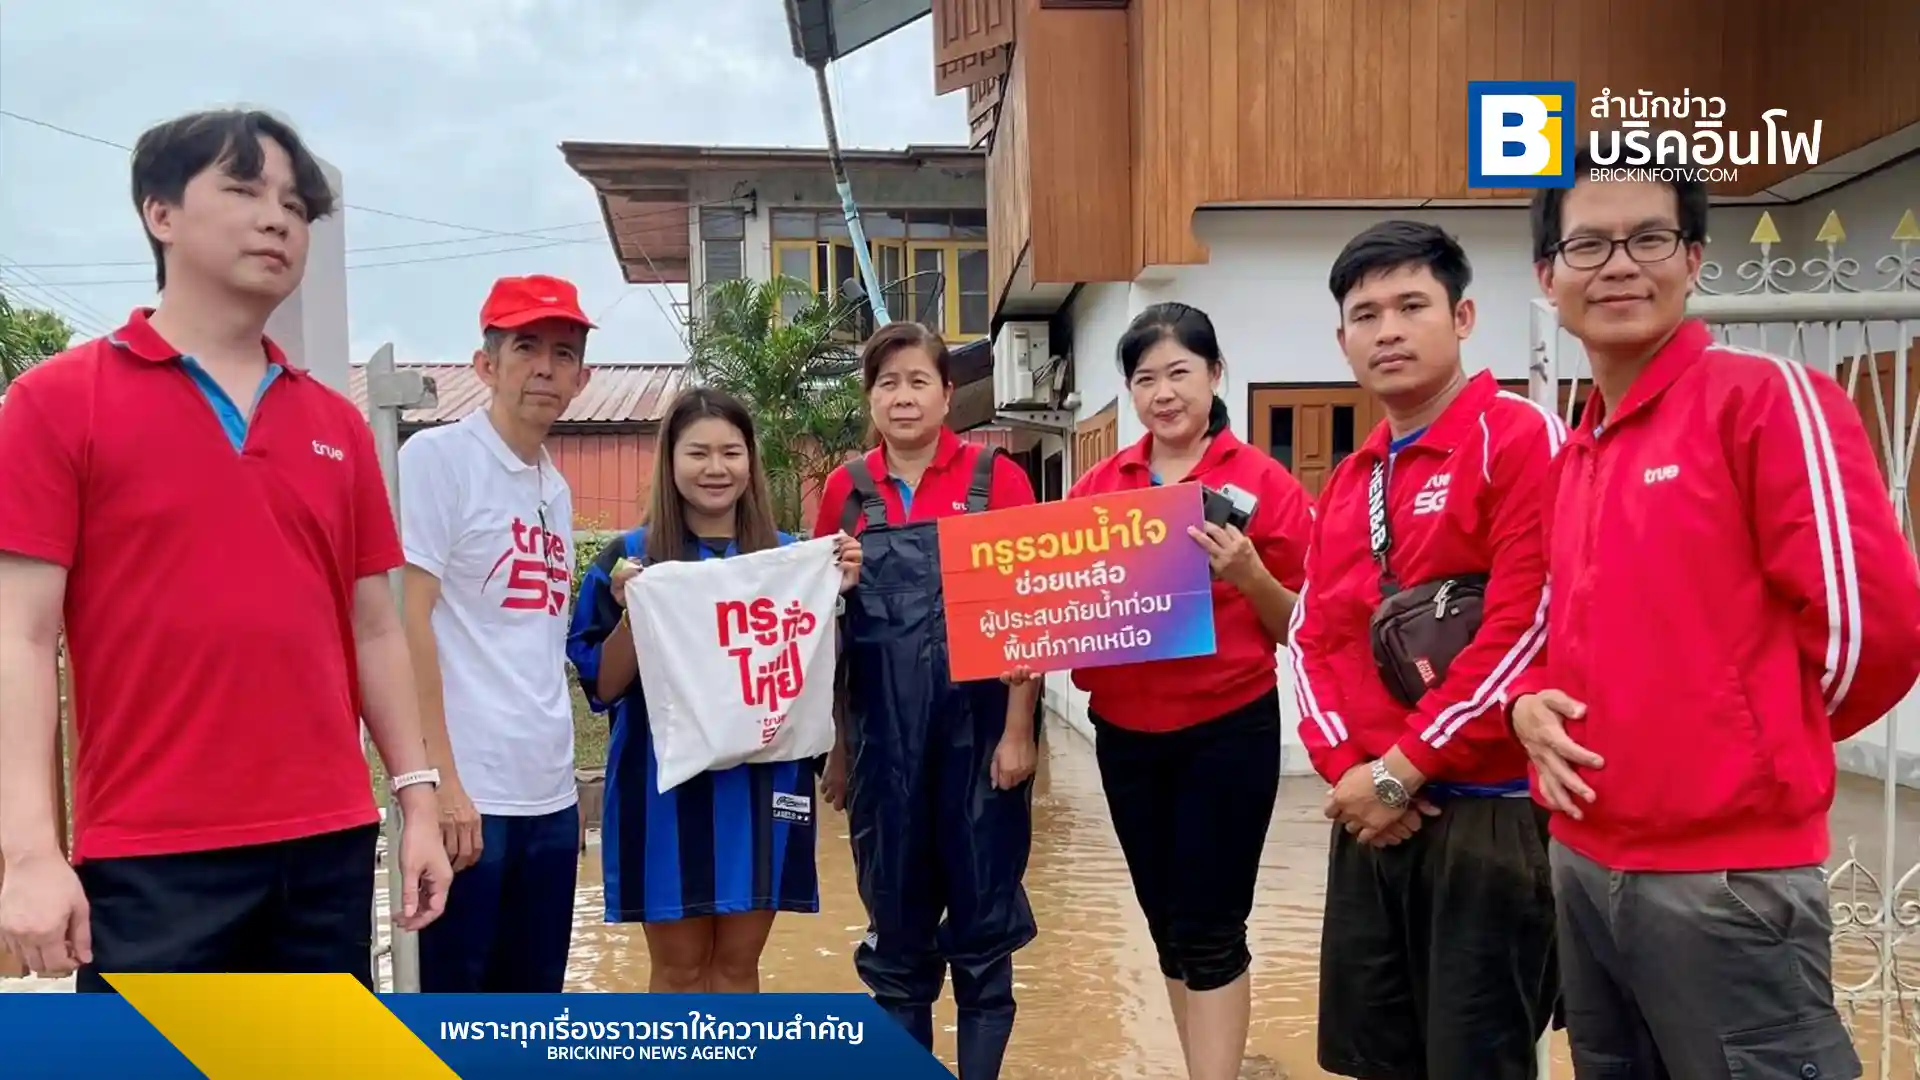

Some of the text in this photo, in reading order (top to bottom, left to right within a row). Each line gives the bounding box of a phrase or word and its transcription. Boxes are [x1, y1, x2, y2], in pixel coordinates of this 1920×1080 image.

[312, 440, 344, 461] true
[970, 506, 1167, 575] ทรูรวมน้ำใจ
[1015, 560, 1126, 595] ช่วยเหลือ
[716, 598, 778, 646] ทรู
[979, 590, 1171, 639] ผู้ประสบภัยน้ำท่วม
[1003, 625, 1152, 661] พื้นที่ภาคเหนือ
